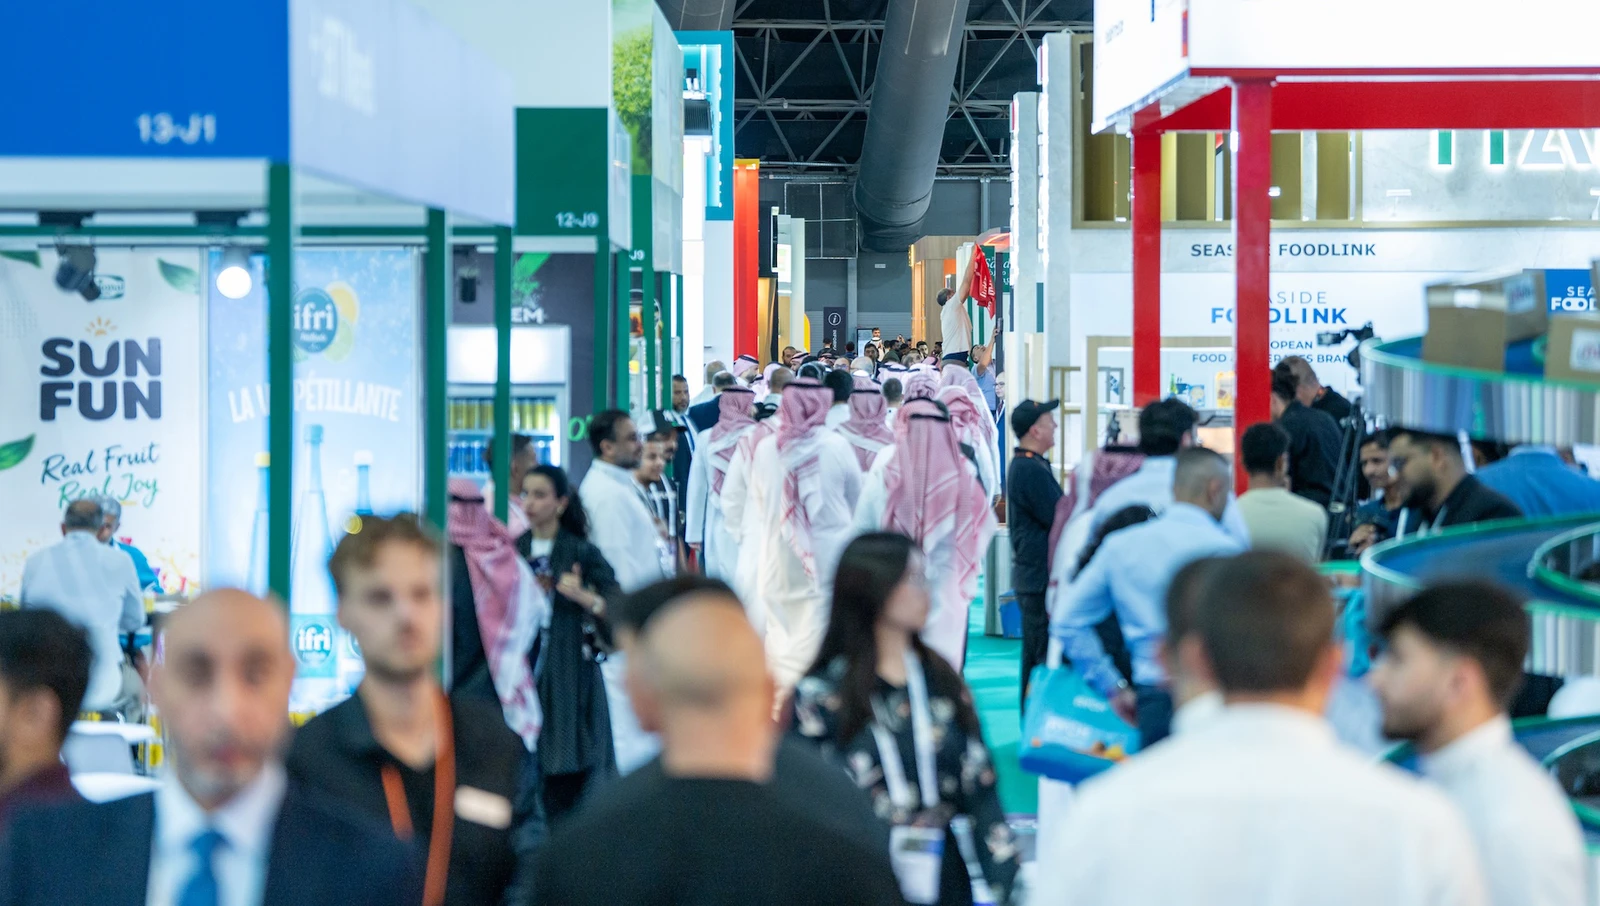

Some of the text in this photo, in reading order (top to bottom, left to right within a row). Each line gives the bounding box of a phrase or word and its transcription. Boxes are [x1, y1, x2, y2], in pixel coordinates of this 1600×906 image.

[555, 212, 599, 228] 12-J9
[1278, 243, 1376, 257] FOODLINK
[1269, 291, 1327, 304] SIDE
[293, 302, 334, 331] ifri
[1211, 307, 1348, 324] FDLINK
[1270, 340, 1313, 350] OPEAN
[40, 337, 162, 378] SUN
[1192, 353, 1227, 363] FOOD
[40, 380, 162, 421] FUN
[227, 386, 255, 424] LA
[41, 441, 160, 485] Real Fruit
[117, 472, 162, 509] Joy
